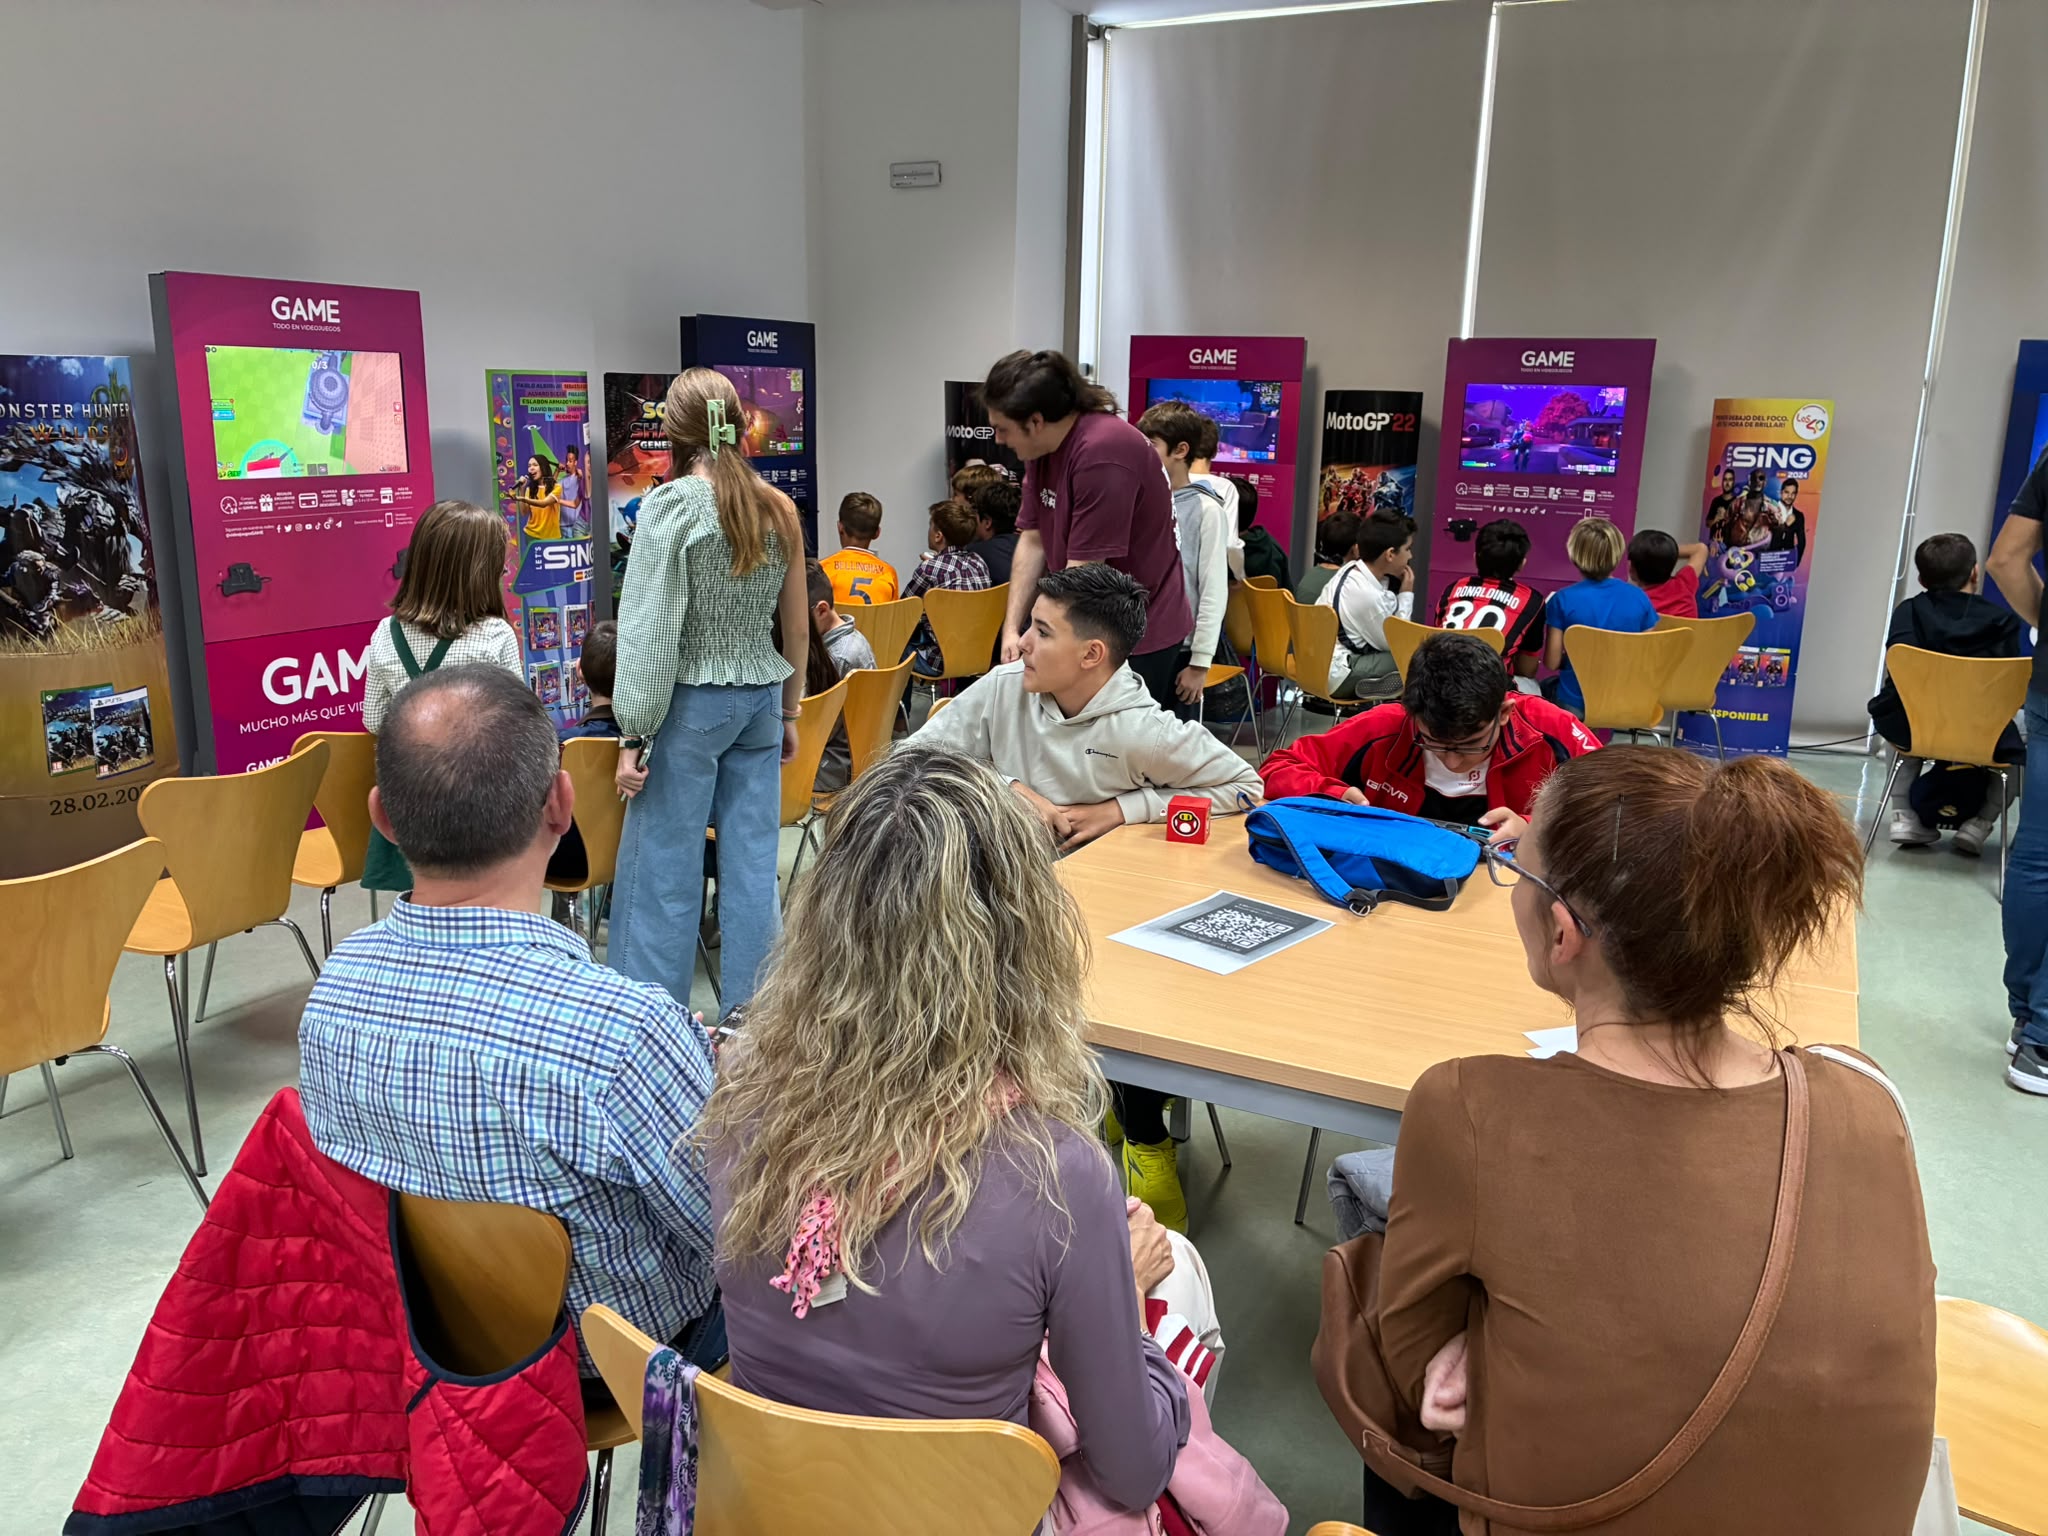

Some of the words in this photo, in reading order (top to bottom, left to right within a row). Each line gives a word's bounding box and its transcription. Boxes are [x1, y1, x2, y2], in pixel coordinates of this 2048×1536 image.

[271, 296, 341, 323] GAME
[747, 330, 778, 348] GAME
[1189, 348, 1238, 364] GAME
[1521, 350, 1575, 367] GAME
[82, 403, 130, 418] HUNTER
[29, 422, 110, 440] WILDS
[1392, 413, 1415, 432] 22
[834, 560, 884, 575] BELLINGHAM
[849, 578, 873, 604] 5
[1453, 586, 1520, 610] RONALDINHO
[1443, 600, 1506, 631] 80
[239, 716, 289, 734] MUCHO
[292, 709, 318, 725] MÁS
[320, 704, 346, 719] QUE
[1709, 708, 1769, 721] ISPONIBLE
[1085, 748, 1119, 759] Champion
